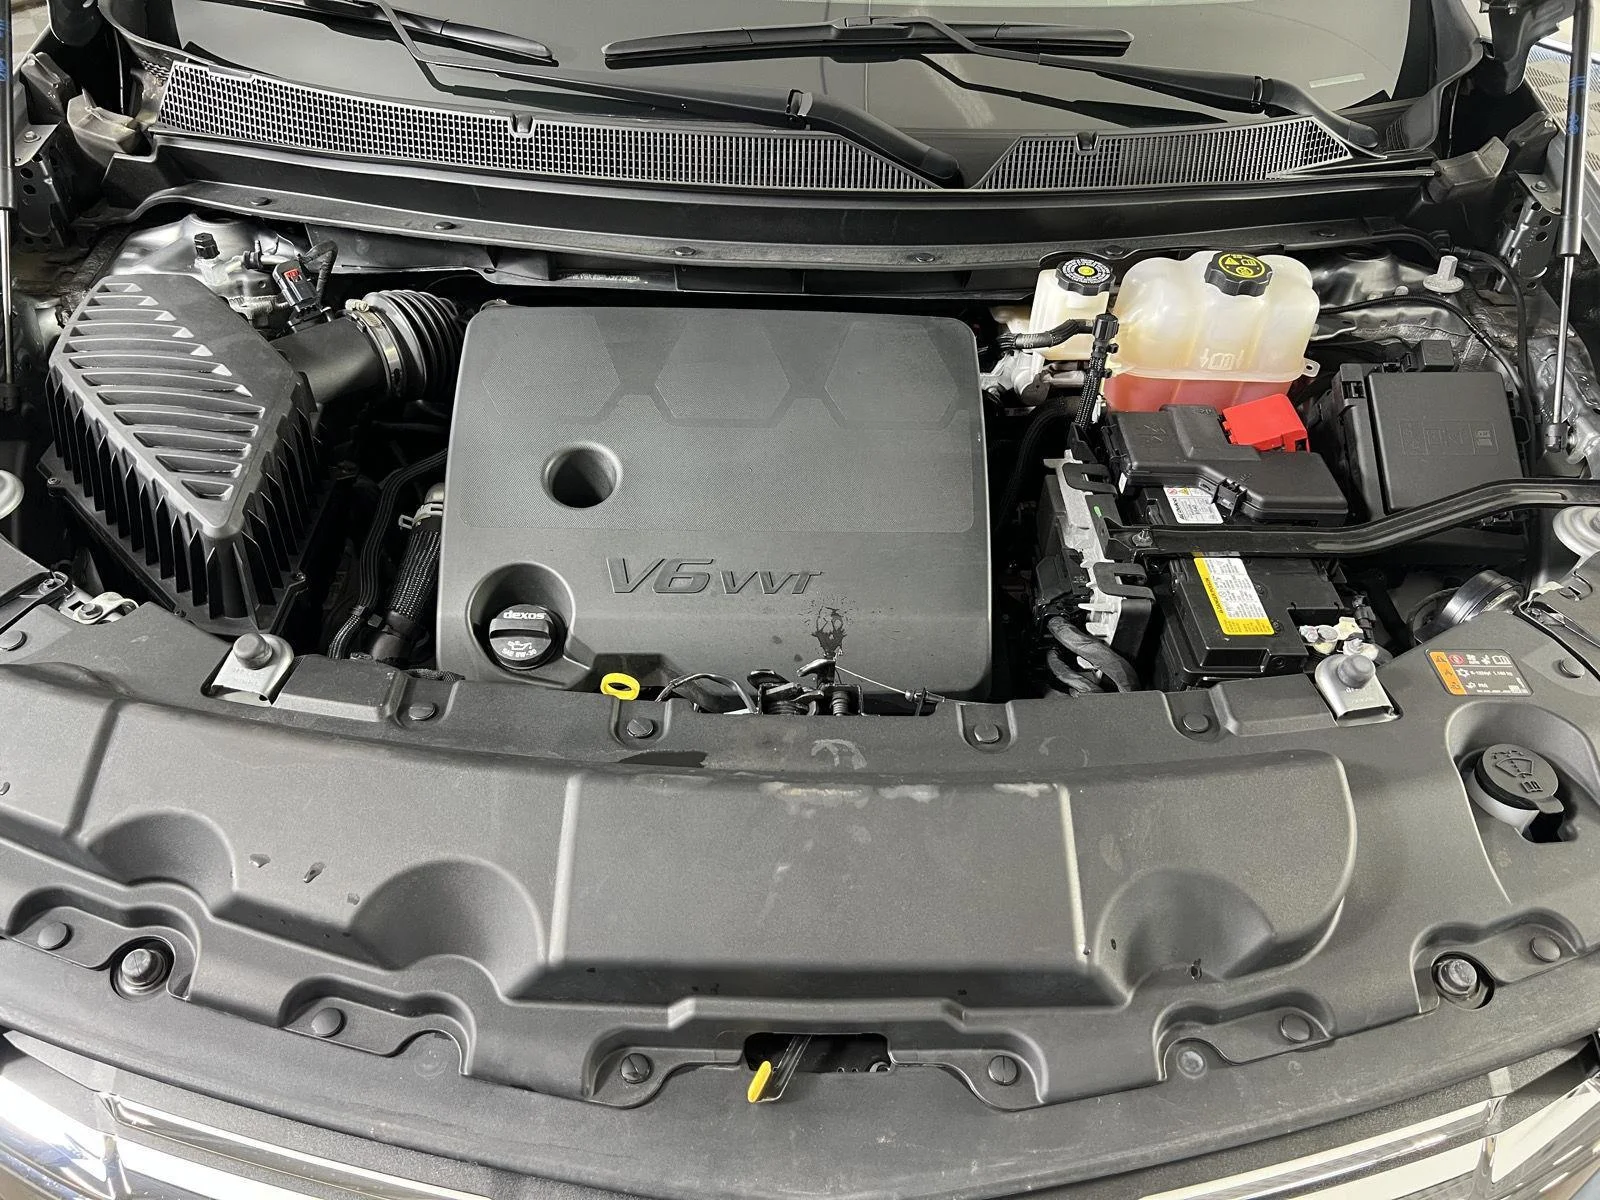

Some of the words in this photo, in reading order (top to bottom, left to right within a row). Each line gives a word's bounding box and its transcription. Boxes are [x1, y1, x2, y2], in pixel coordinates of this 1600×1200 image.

[606, 558, 714, 594] V6
[719, 570, 825, 595] VVT
[503, 610, 546, 620] dexos
